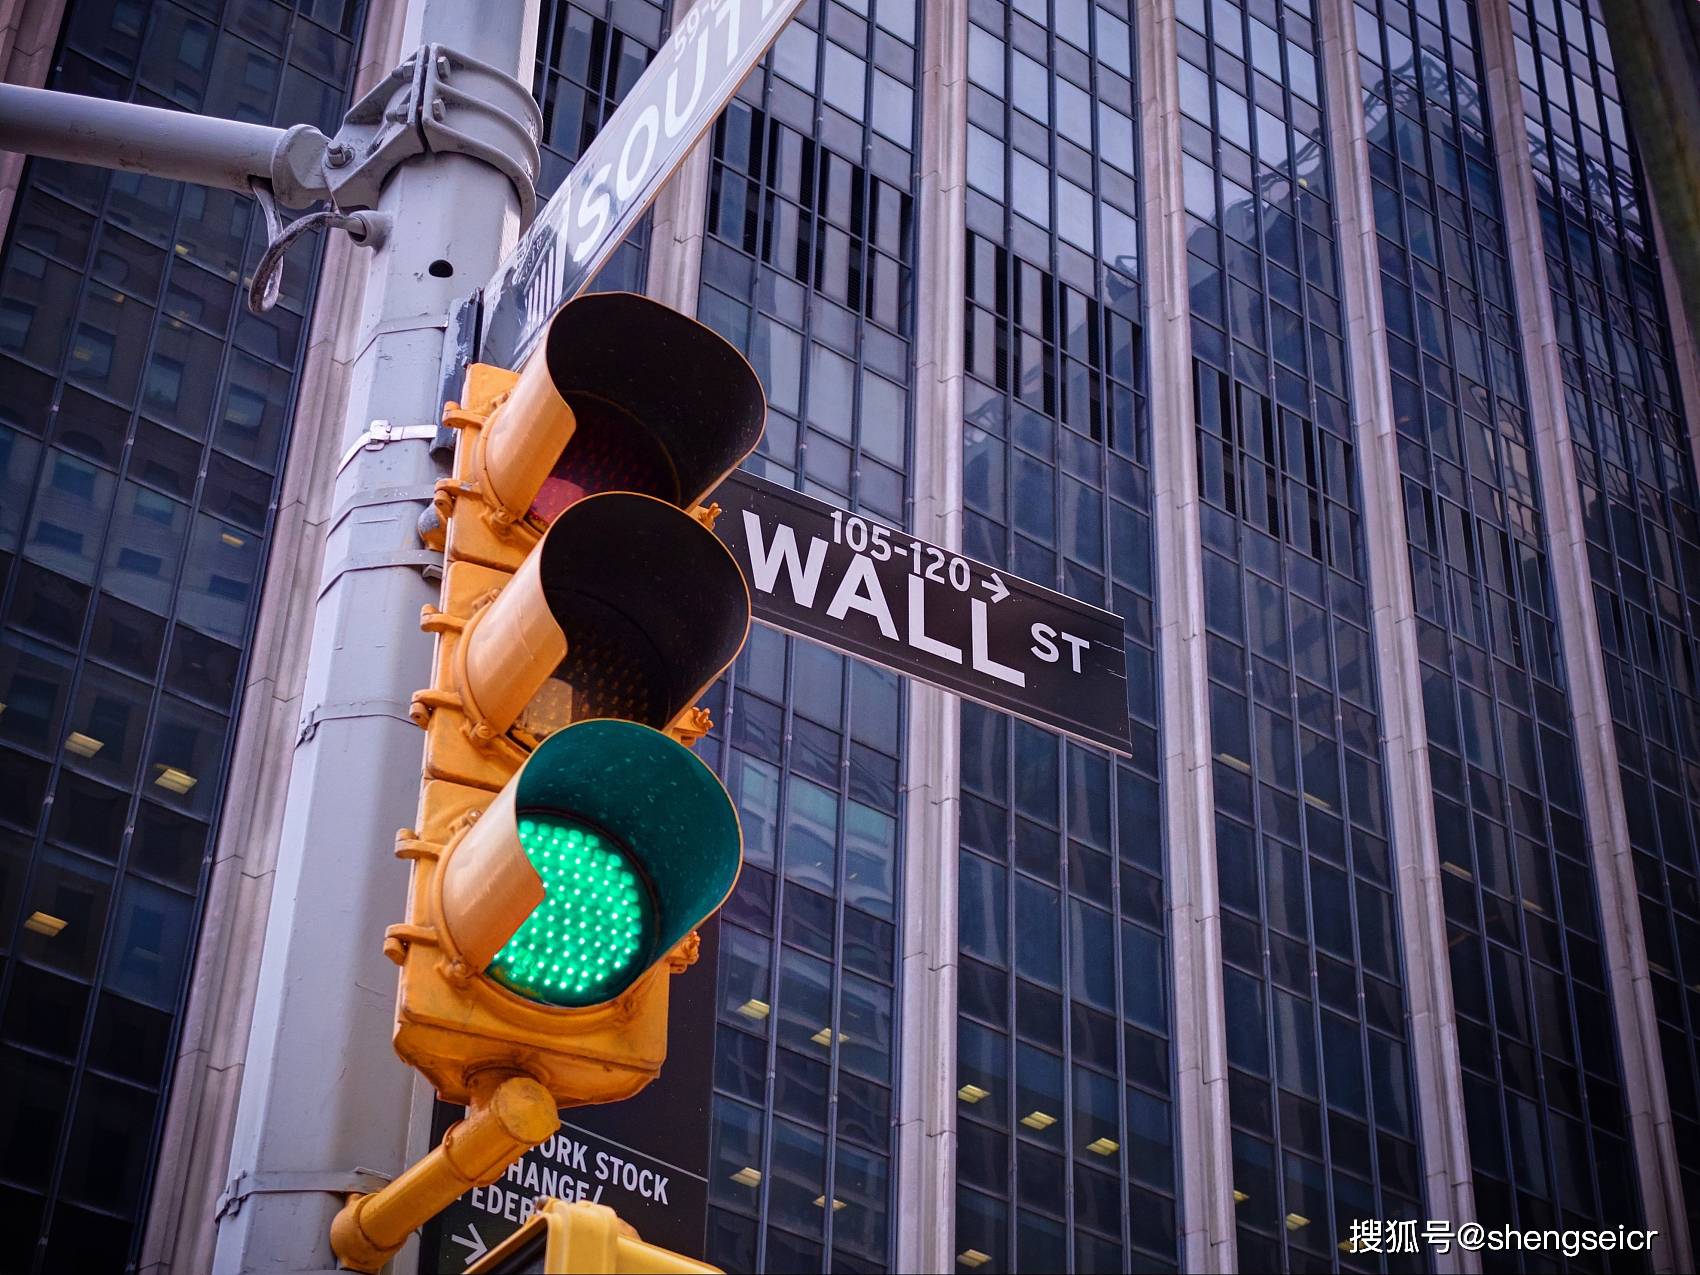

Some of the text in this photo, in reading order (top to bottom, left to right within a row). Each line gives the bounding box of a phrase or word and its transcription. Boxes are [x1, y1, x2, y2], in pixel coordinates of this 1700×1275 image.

[573, 0, 775, 263] SOUT
[830, 510, 971, 592] 105-120
[742, 509, 1090, 688] WALL ST
[457, 1184, 535, 1225] EDER
[500, 1157, 603, 1204] HANGE/
[530, 1134, 669, 1205] ORK STOCK
